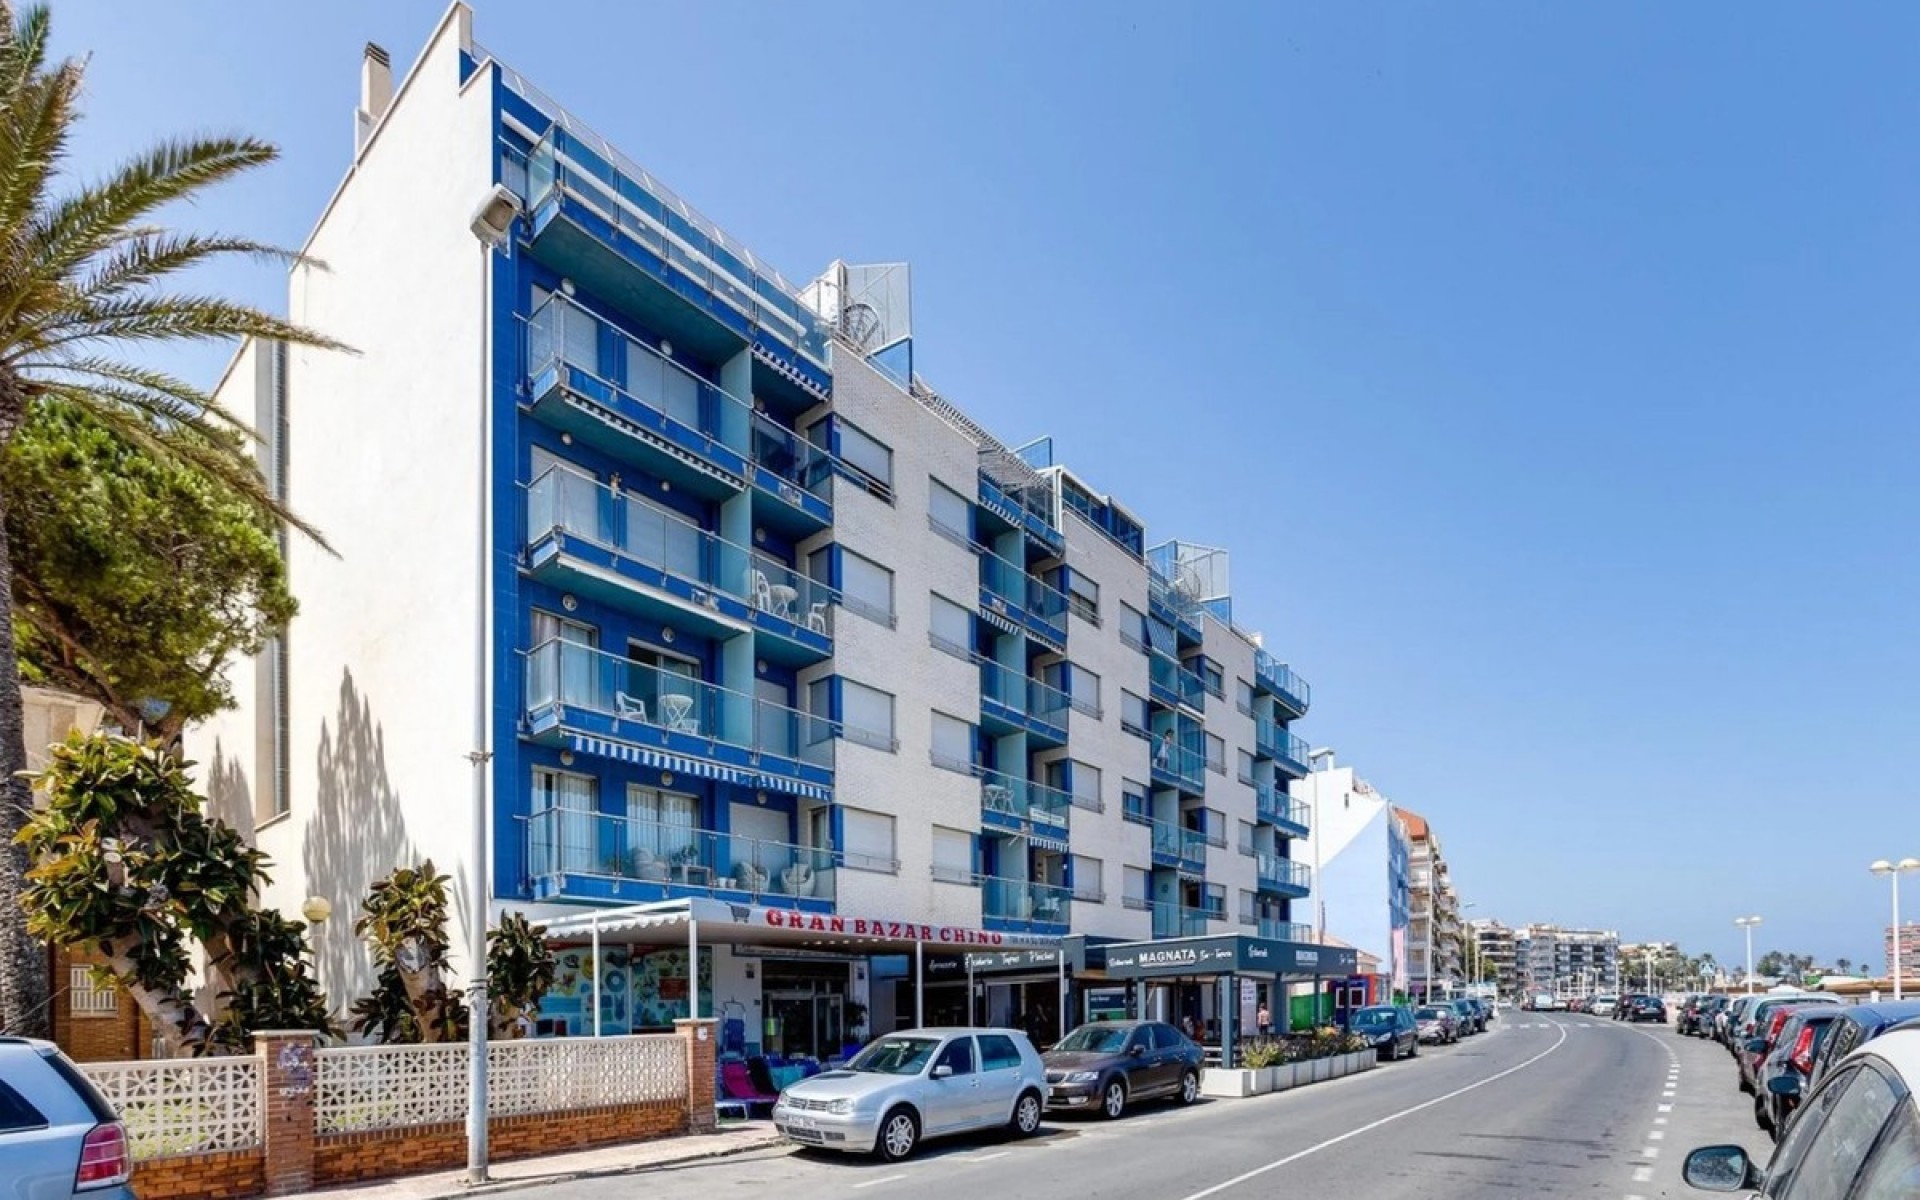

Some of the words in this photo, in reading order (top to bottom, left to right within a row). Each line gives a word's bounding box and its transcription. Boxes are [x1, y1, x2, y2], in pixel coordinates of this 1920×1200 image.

[766, 908, 845, 932] GRAN
[854, 918, 933, 940] BAZAR
[940, 926, 1003, 945] CHINO
[1138, 948, 1197, 963] MAGNATA
